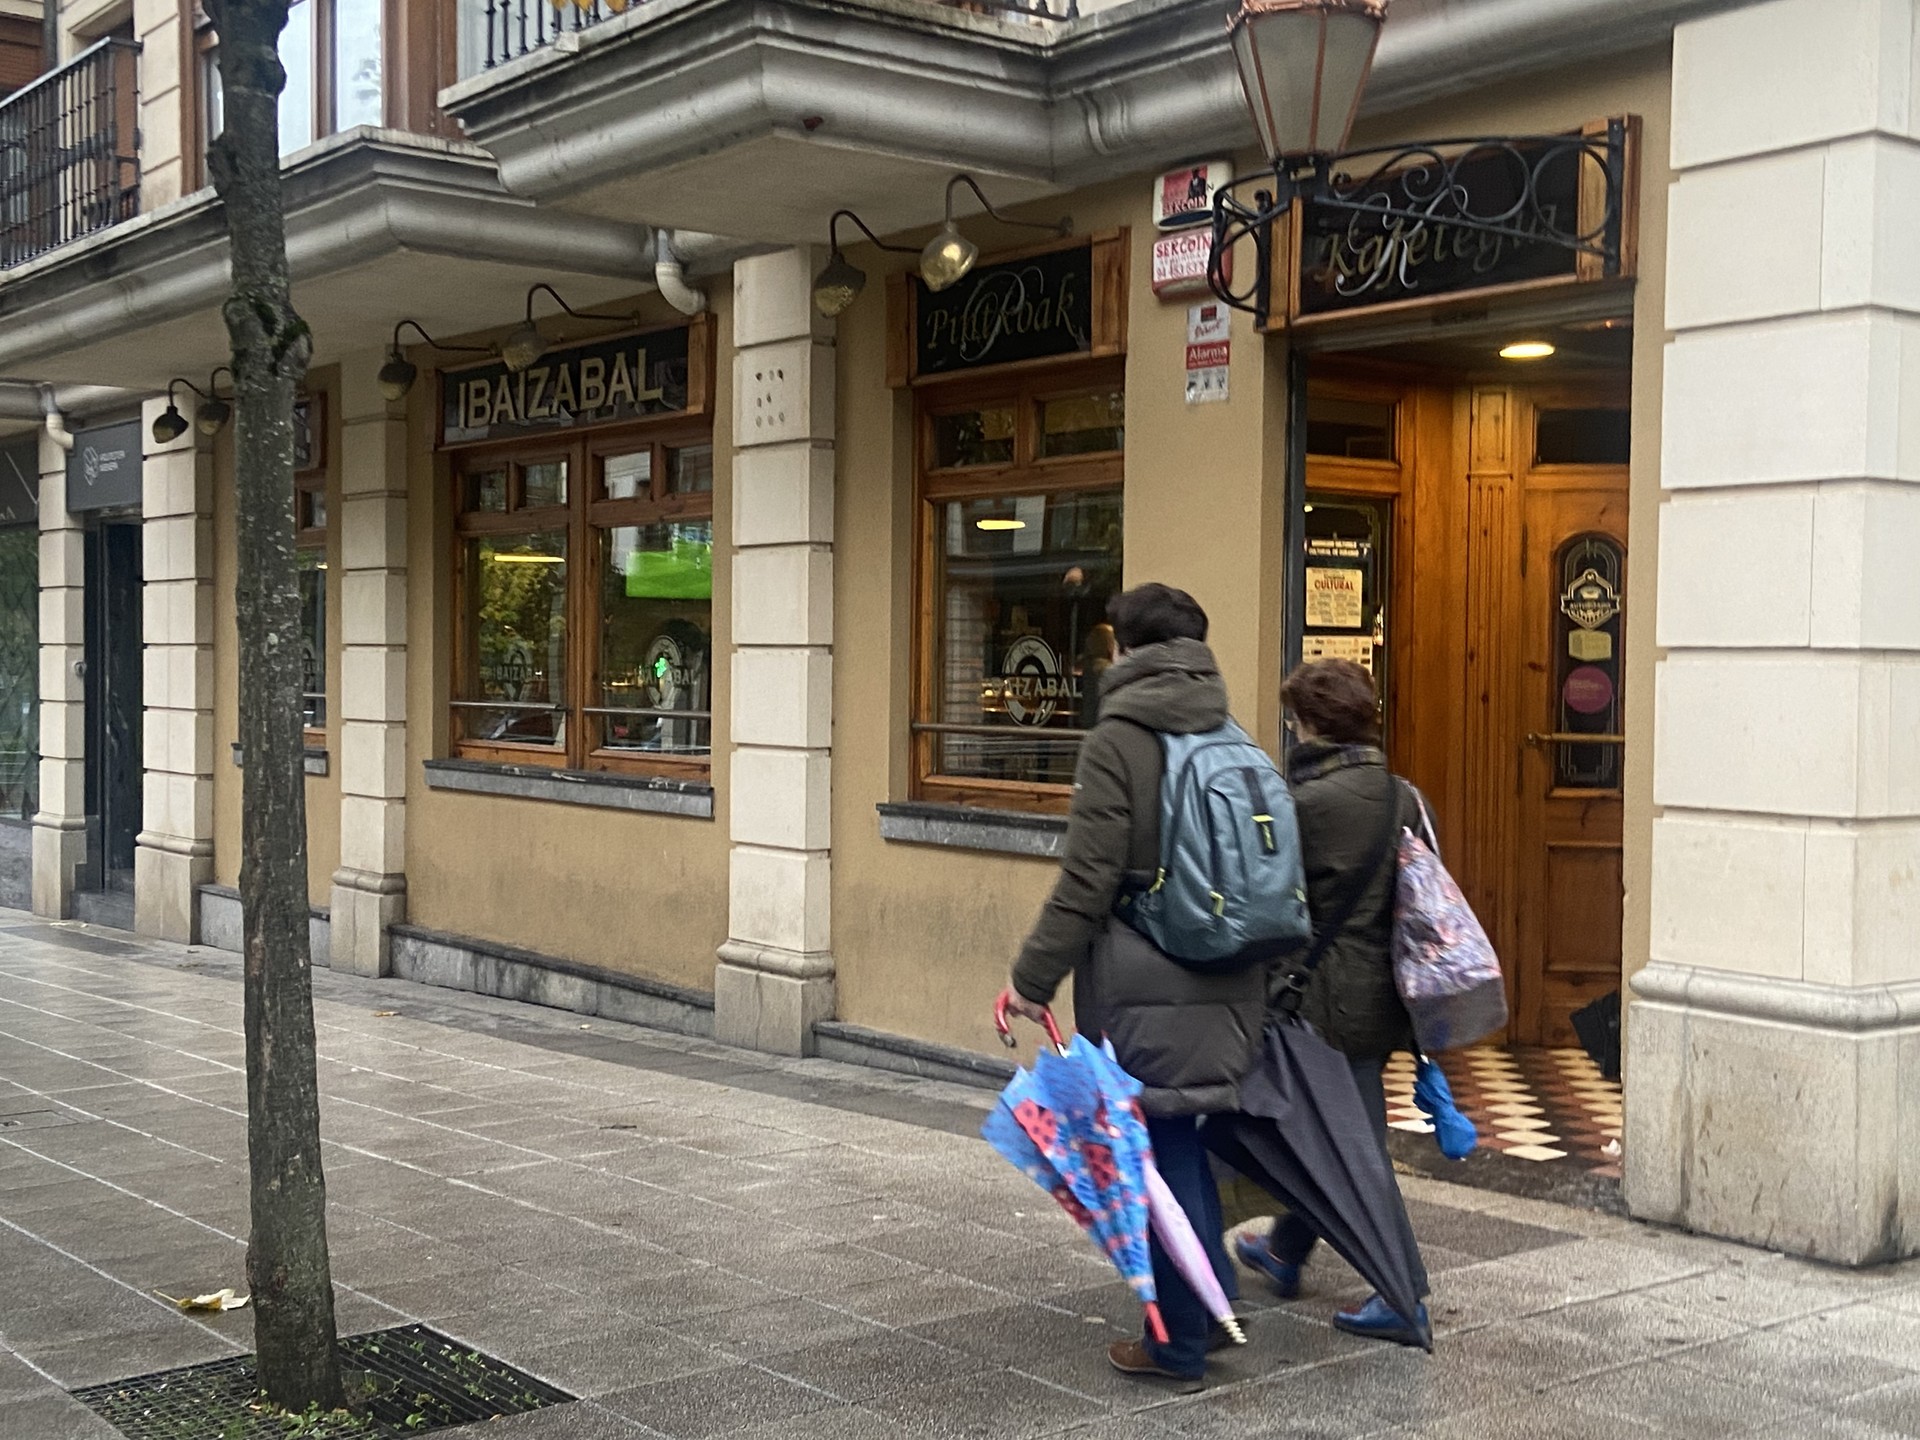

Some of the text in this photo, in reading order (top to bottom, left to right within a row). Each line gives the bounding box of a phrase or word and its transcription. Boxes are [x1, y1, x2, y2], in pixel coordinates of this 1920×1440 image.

[1156, 234, 1212, 258] SERCOIN
[1189, 345, 1228, 362] Alarma
[458, 348, 664, 430] IBAIZABAL
[1314, 579, 1355, 592] CULTURAL
[493, 664, 544, 685] IBAIZAB
[985, 675, 1083, 699] AIZABAL
